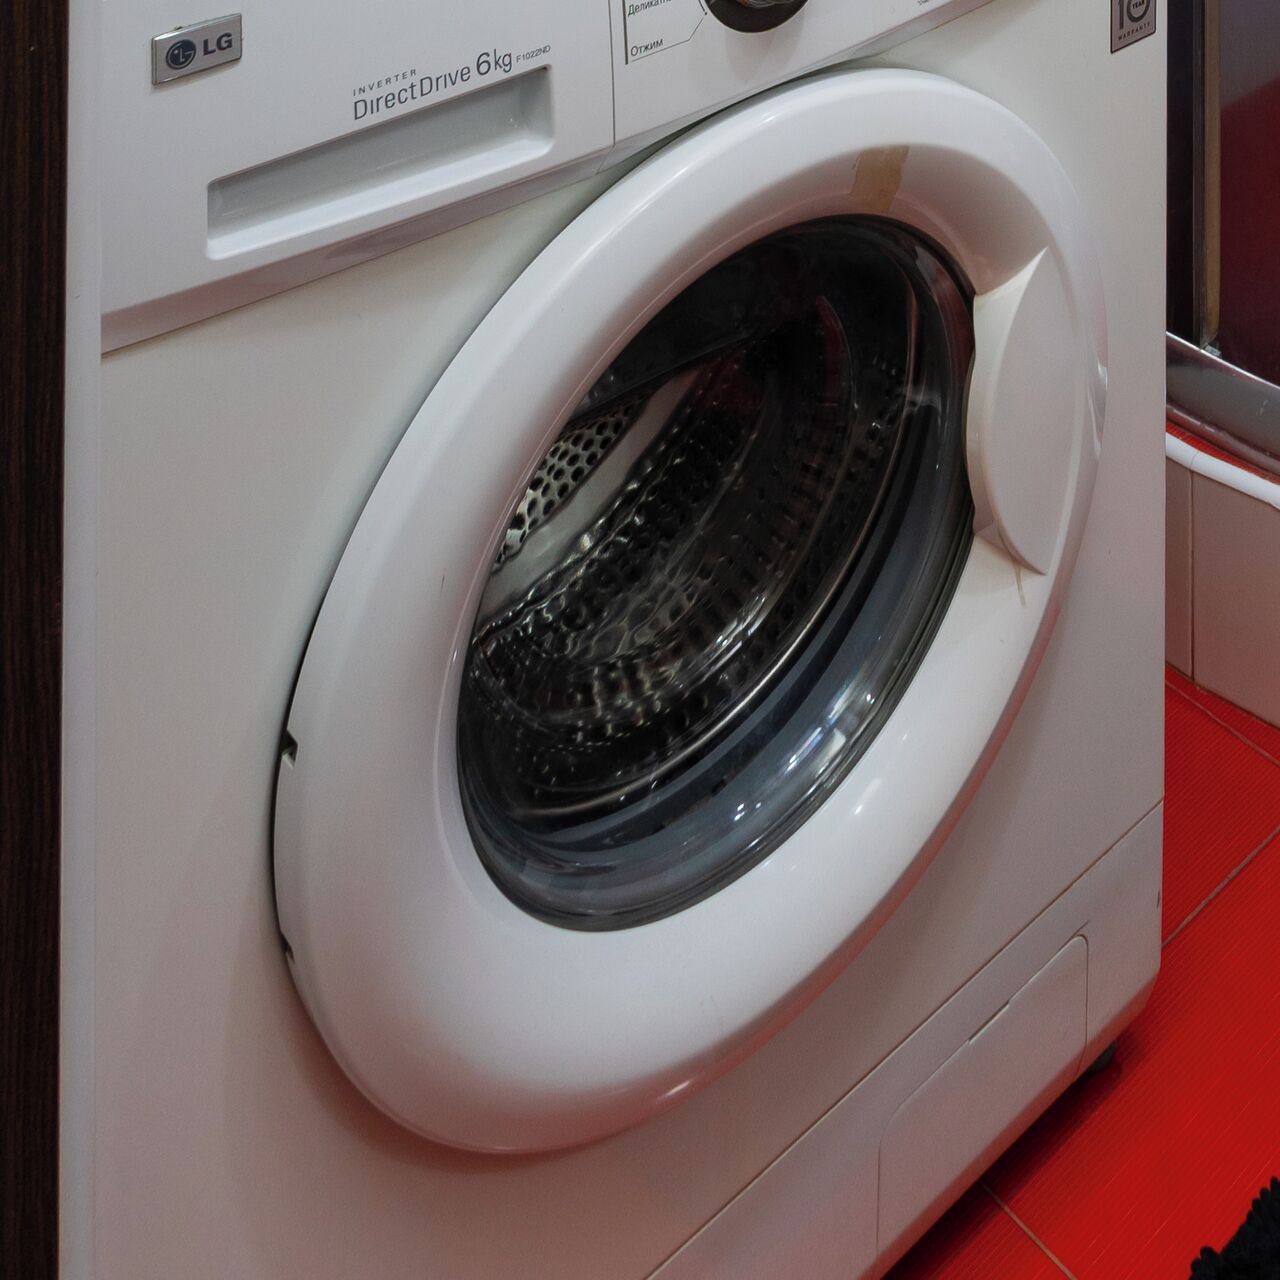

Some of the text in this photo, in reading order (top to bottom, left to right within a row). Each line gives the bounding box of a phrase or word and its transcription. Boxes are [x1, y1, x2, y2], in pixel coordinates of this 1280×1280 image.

[1117, 21, 1151, 41] WARRANTY
[203, 32, 233, 56] LG
[630, 38, 664, 57] Отжим
[353, 68, 417, 97] INVERTER
